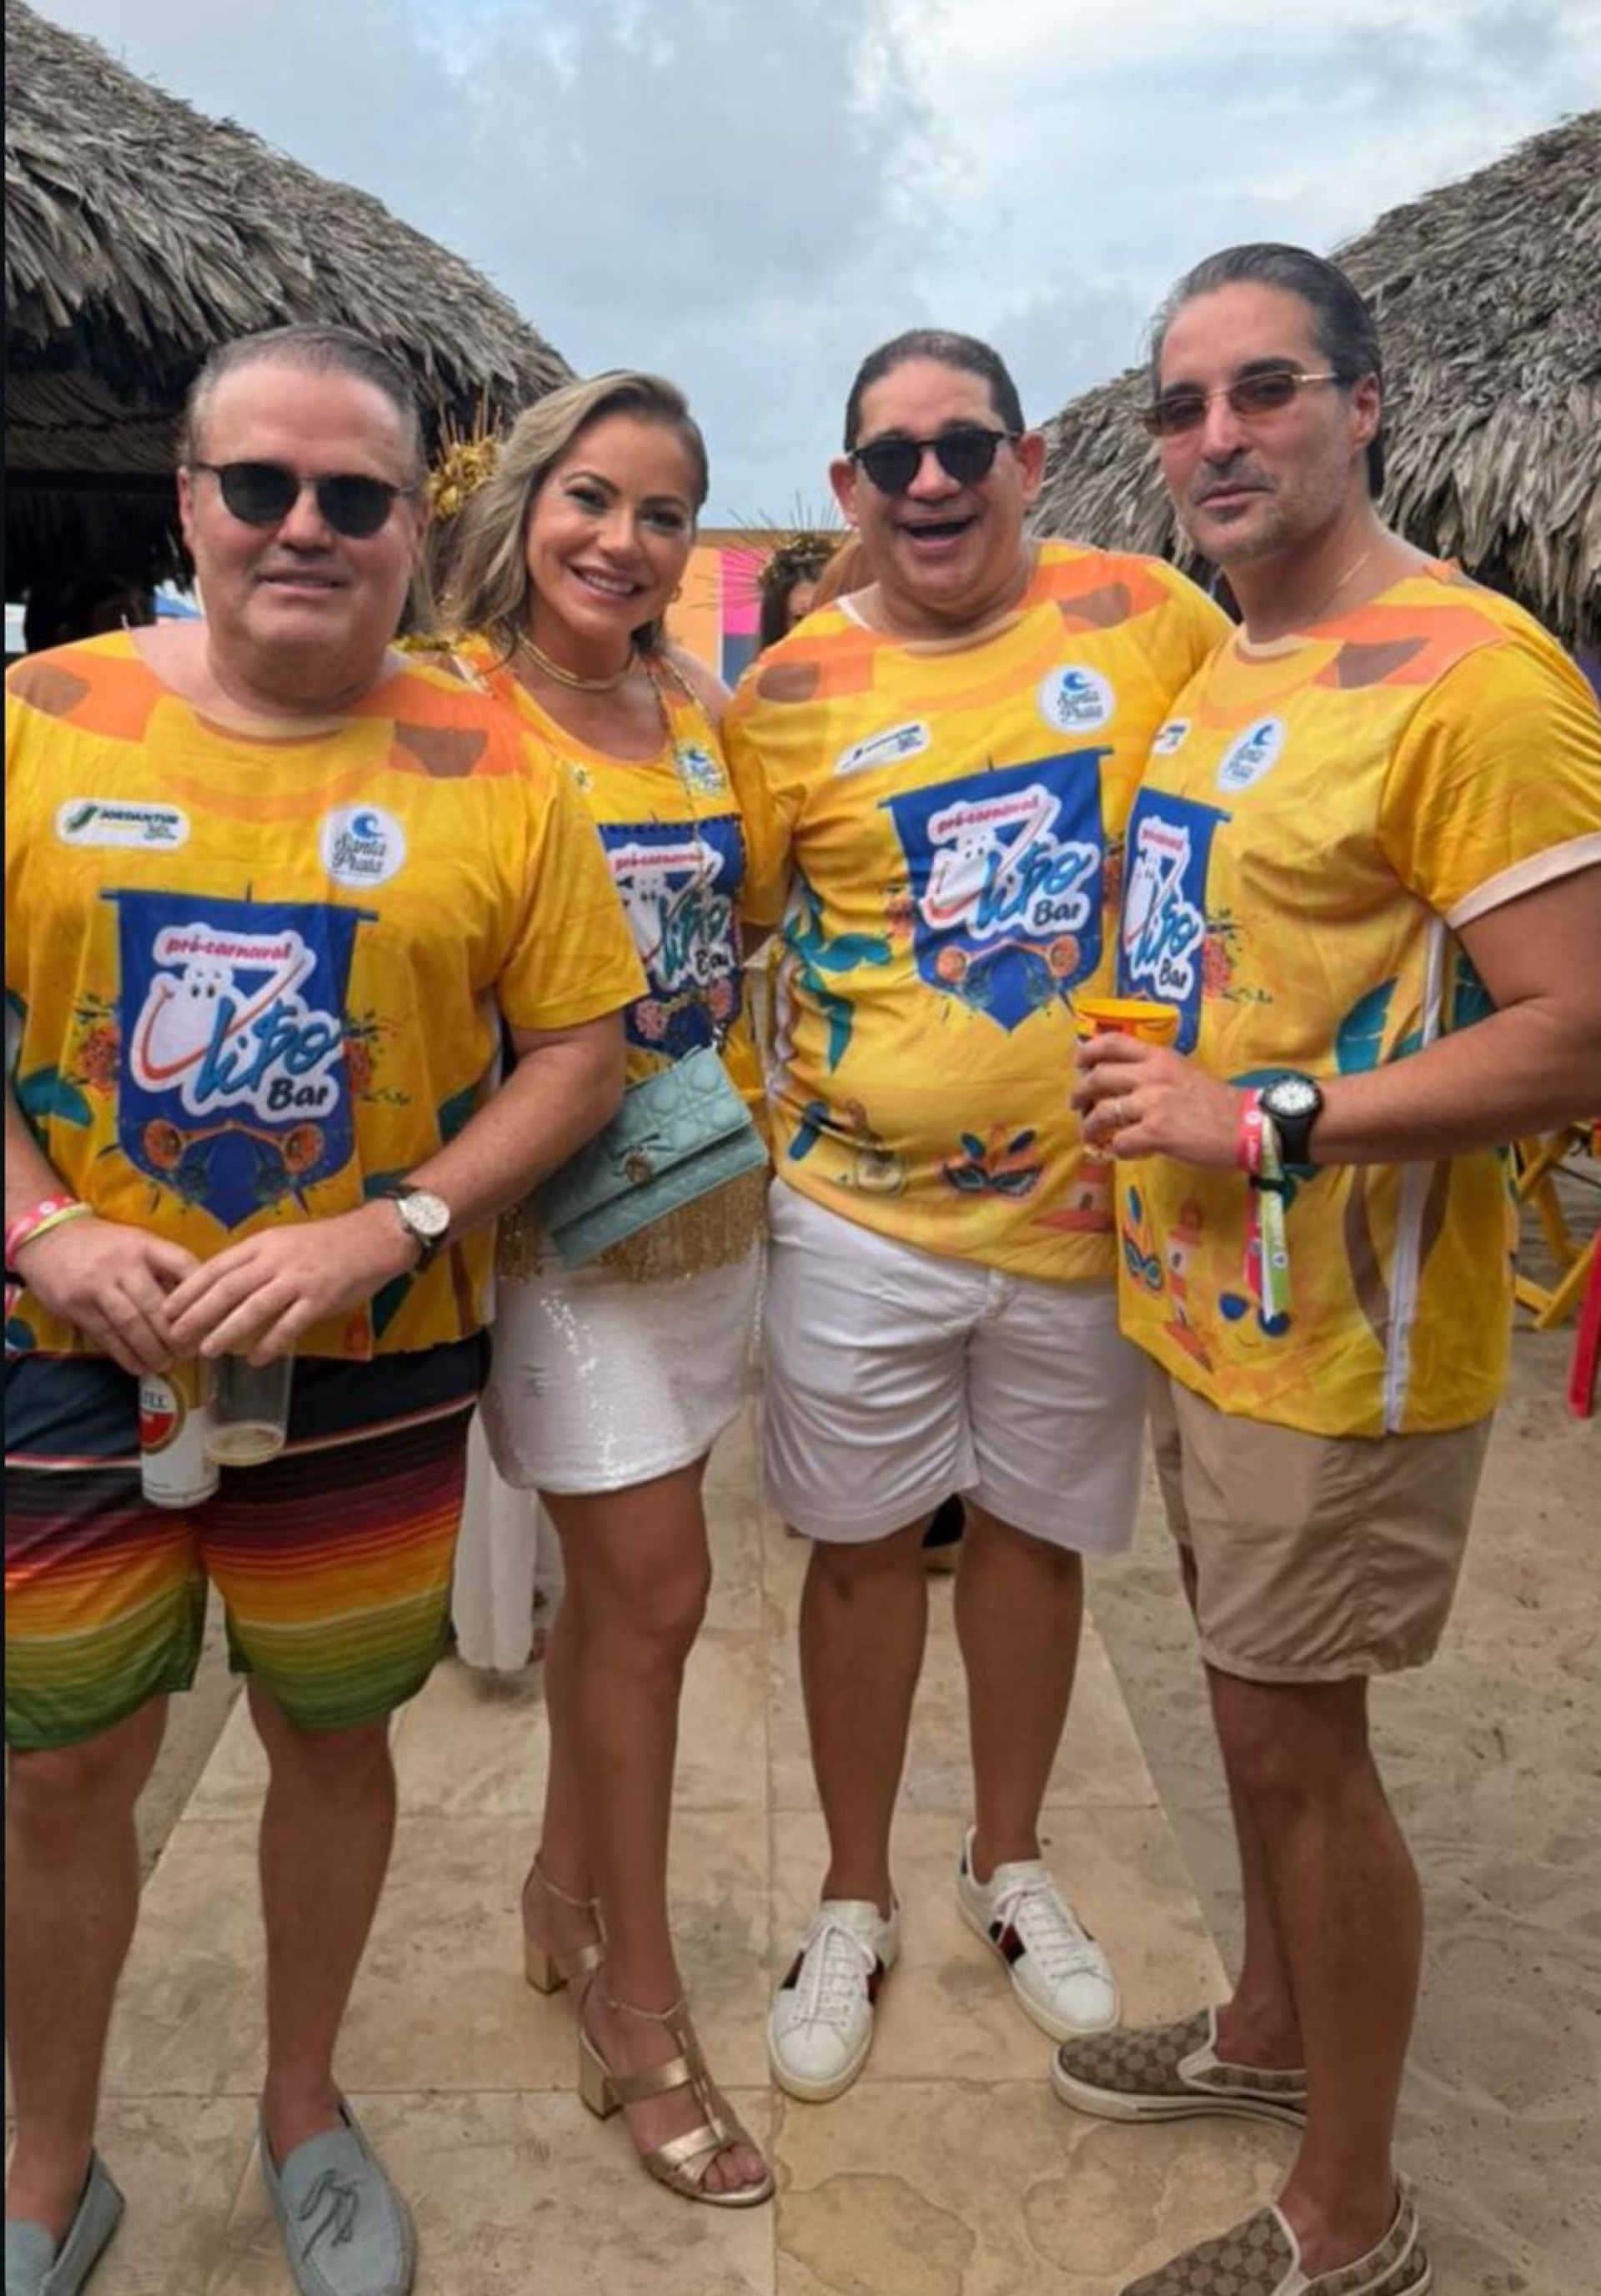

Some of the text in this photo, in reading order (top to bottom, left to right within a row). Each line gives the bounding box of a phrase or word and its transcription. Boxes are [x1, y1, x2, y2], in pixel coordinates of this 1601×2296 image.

[1035, 899, 1082, 927] Bar
[165, 935, 293, 960] pré-carnaval
[267, 1078, 329, 1111] Bar
